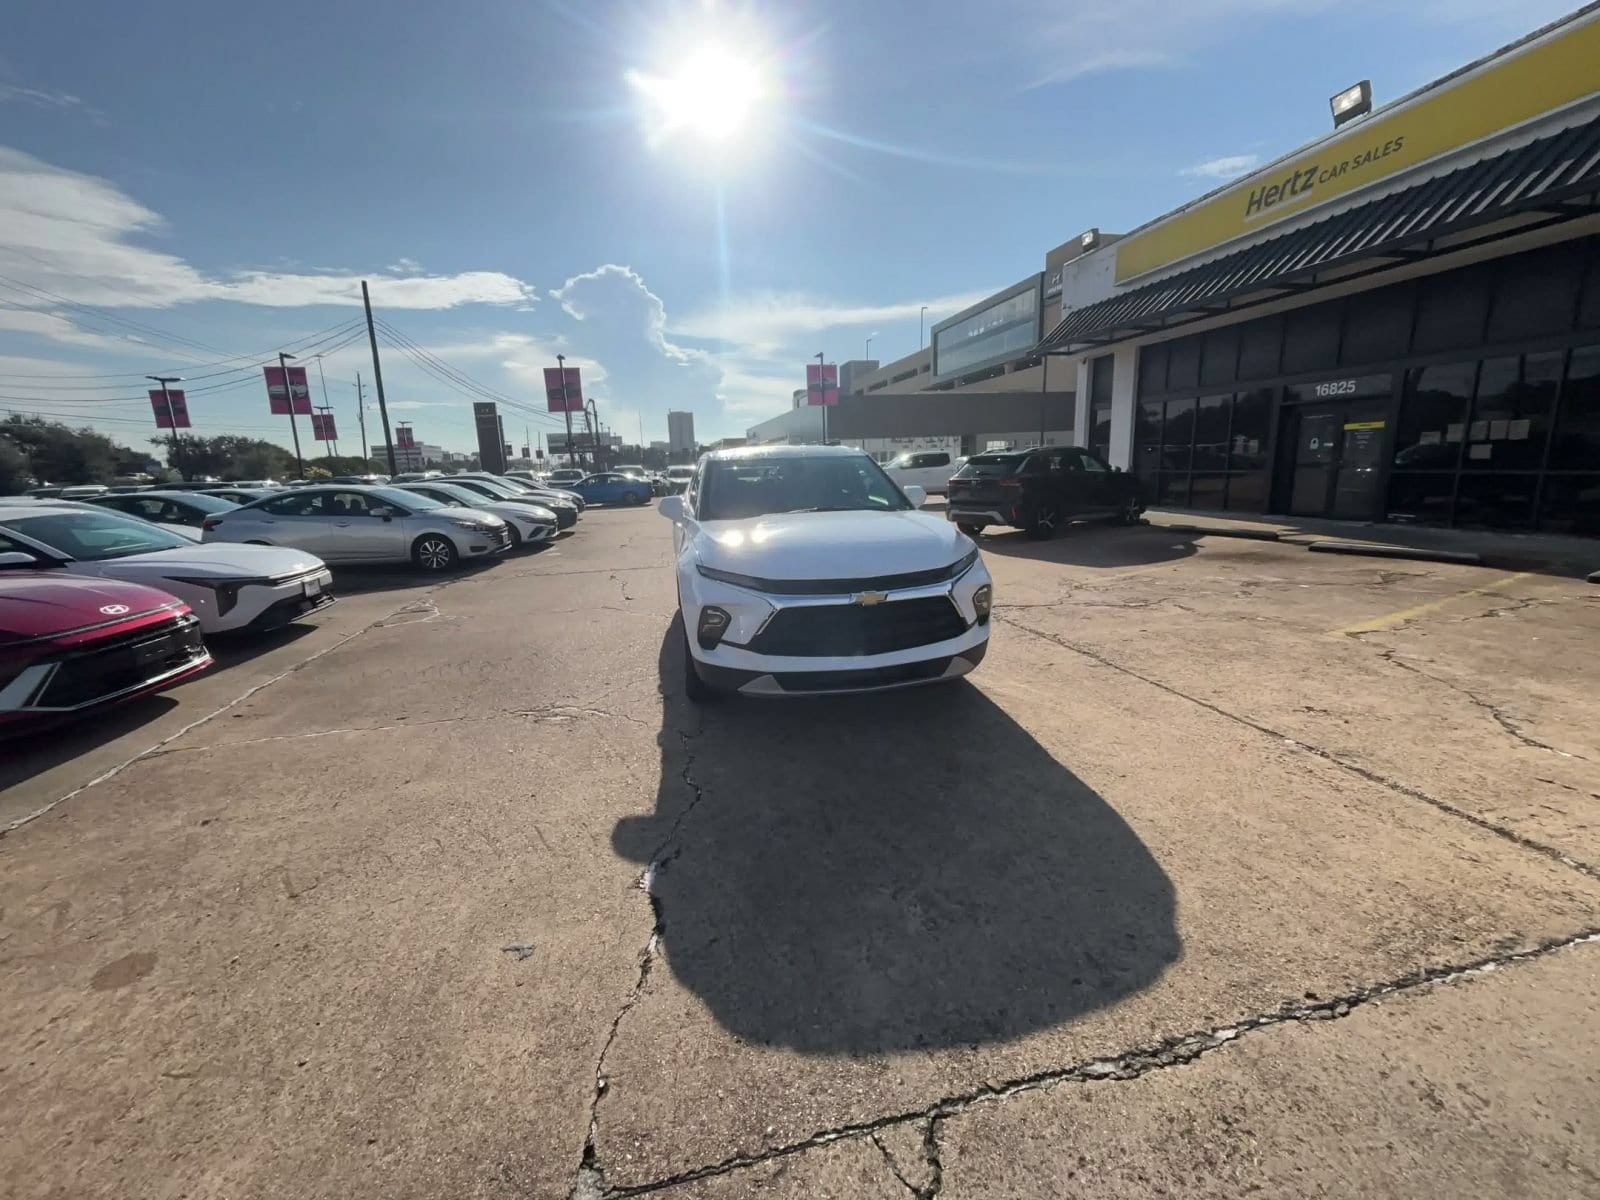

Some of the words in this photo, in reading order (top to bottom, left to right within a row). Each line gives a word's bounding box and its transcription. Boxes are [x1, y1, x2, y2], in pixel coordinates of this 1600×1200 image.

[1245, 165, 1319, 216] Hertz
[1318, 160, 1349, 184] CAR
[1351, 136, 1404, 170] SALES
[1315, 380, 1356, 397] 16825
